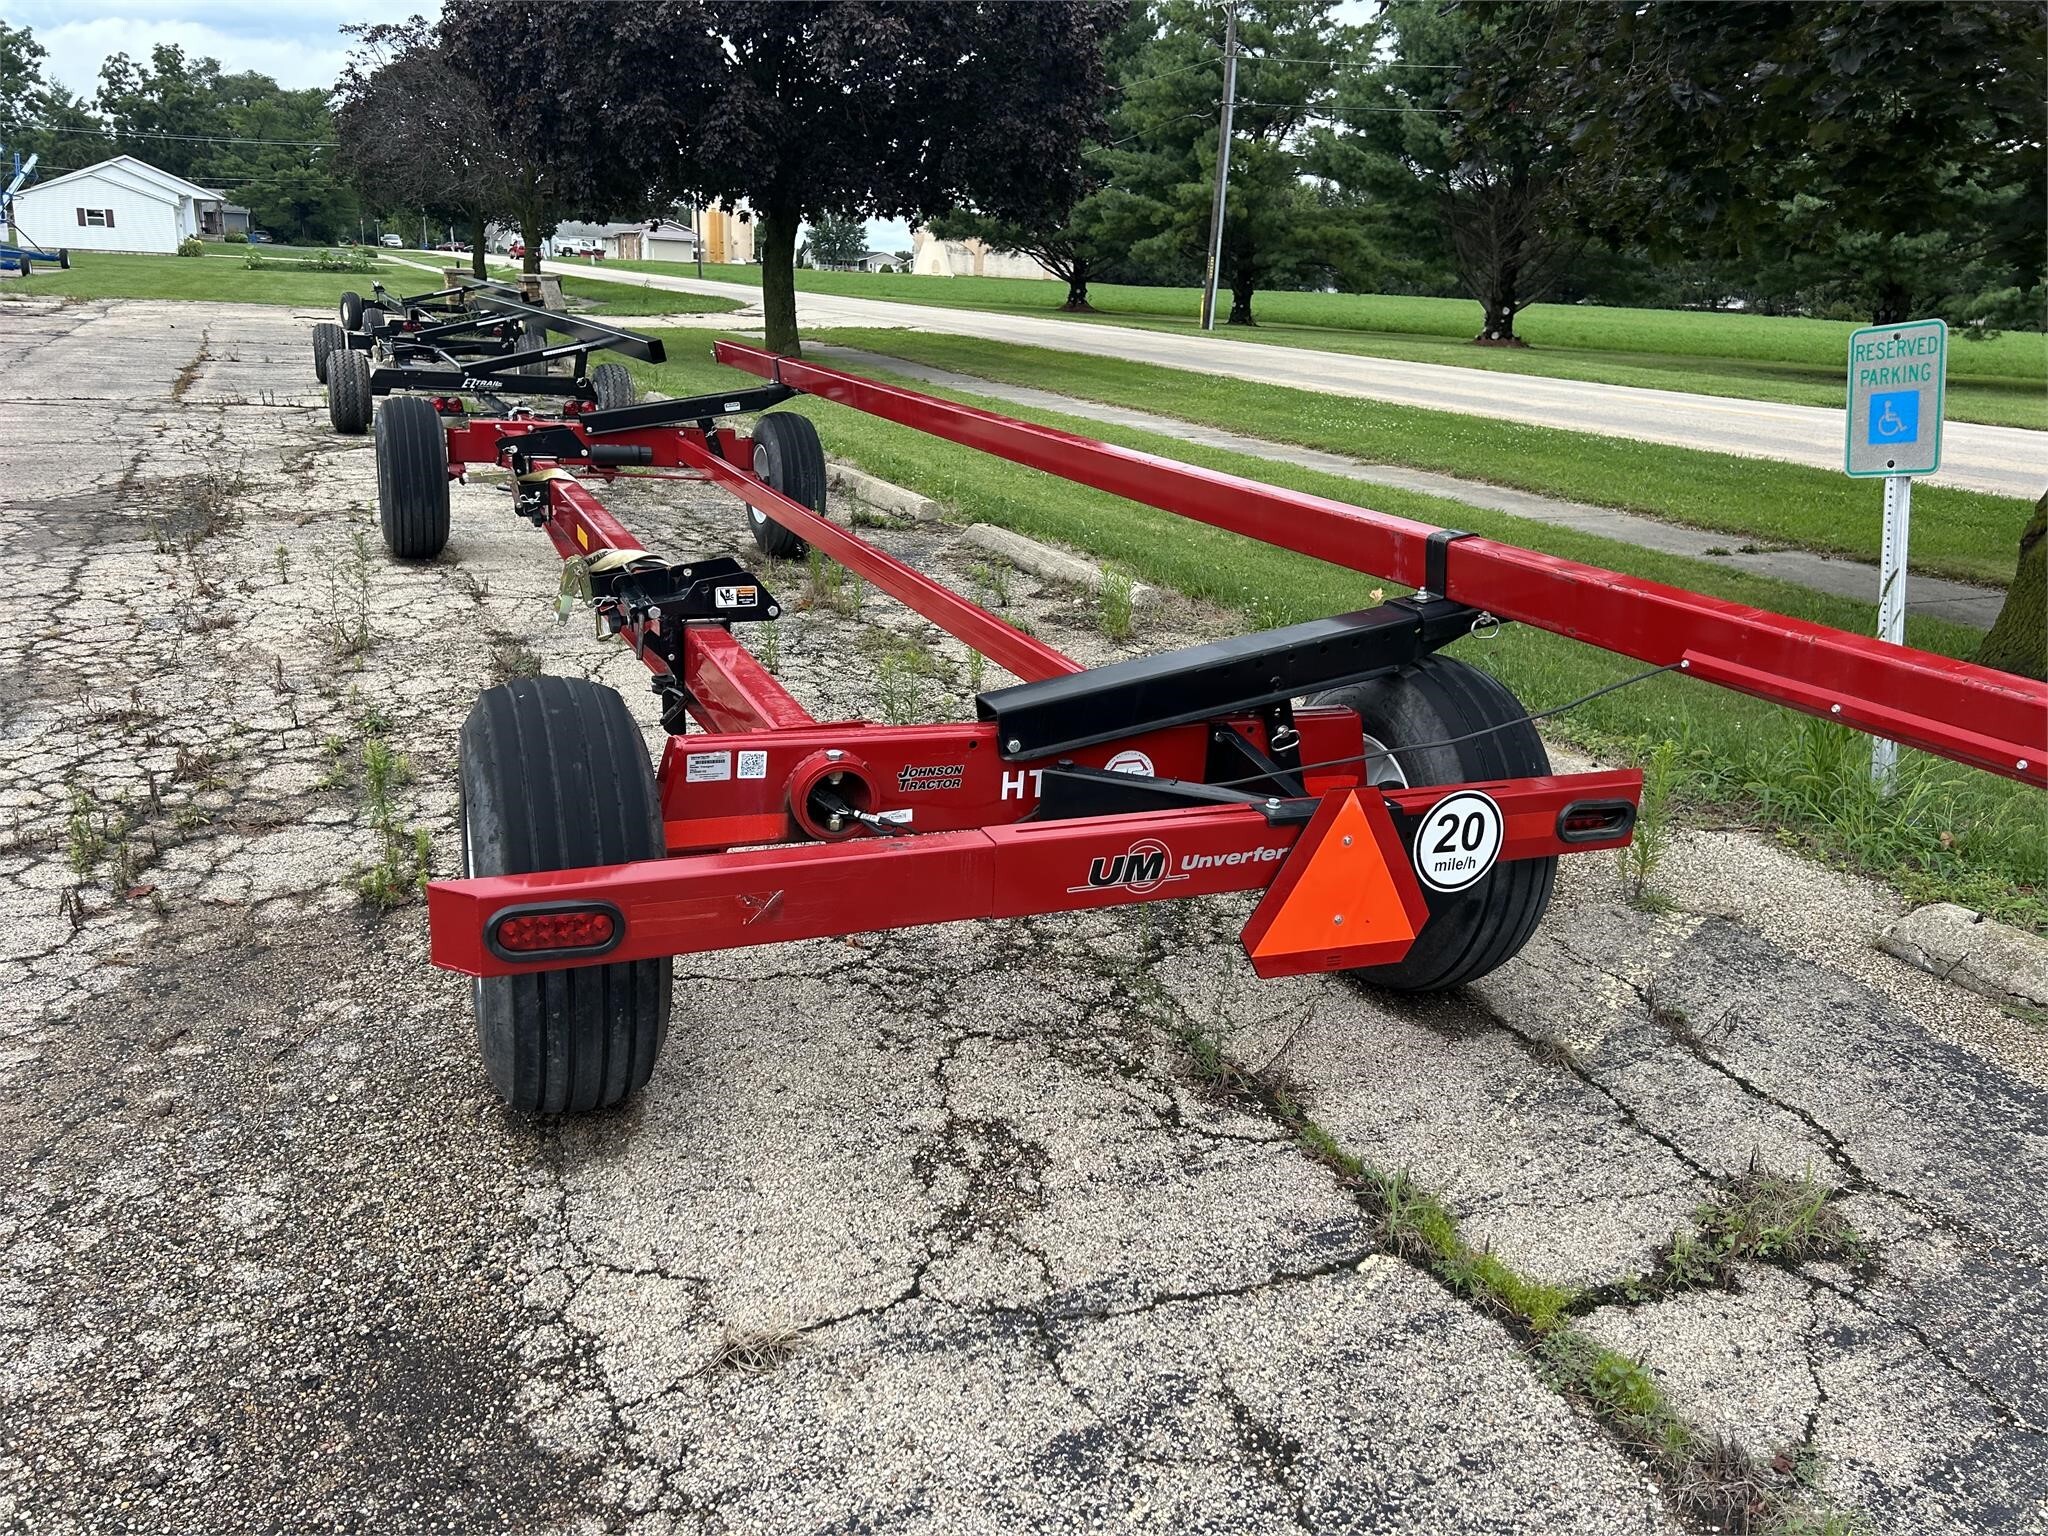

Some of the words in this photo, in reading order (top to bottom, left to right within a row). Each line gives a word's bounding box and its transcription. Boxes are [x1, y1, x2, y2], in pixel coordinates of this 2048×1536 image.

[1855, 336, 1938, 362] RESERVED
[1860, 362, 1932, 387] PARKING
[897, 764, 964, 778] JOHNSON
[898, 778, 962, 792] TRACTOR
[1432, 811, 1485, 854] 20
[1088, 851, 1165, 887] UM
[1181, 846, 1292, 870] Unverfer
[1434, 856, 1477, 872] mile/h
